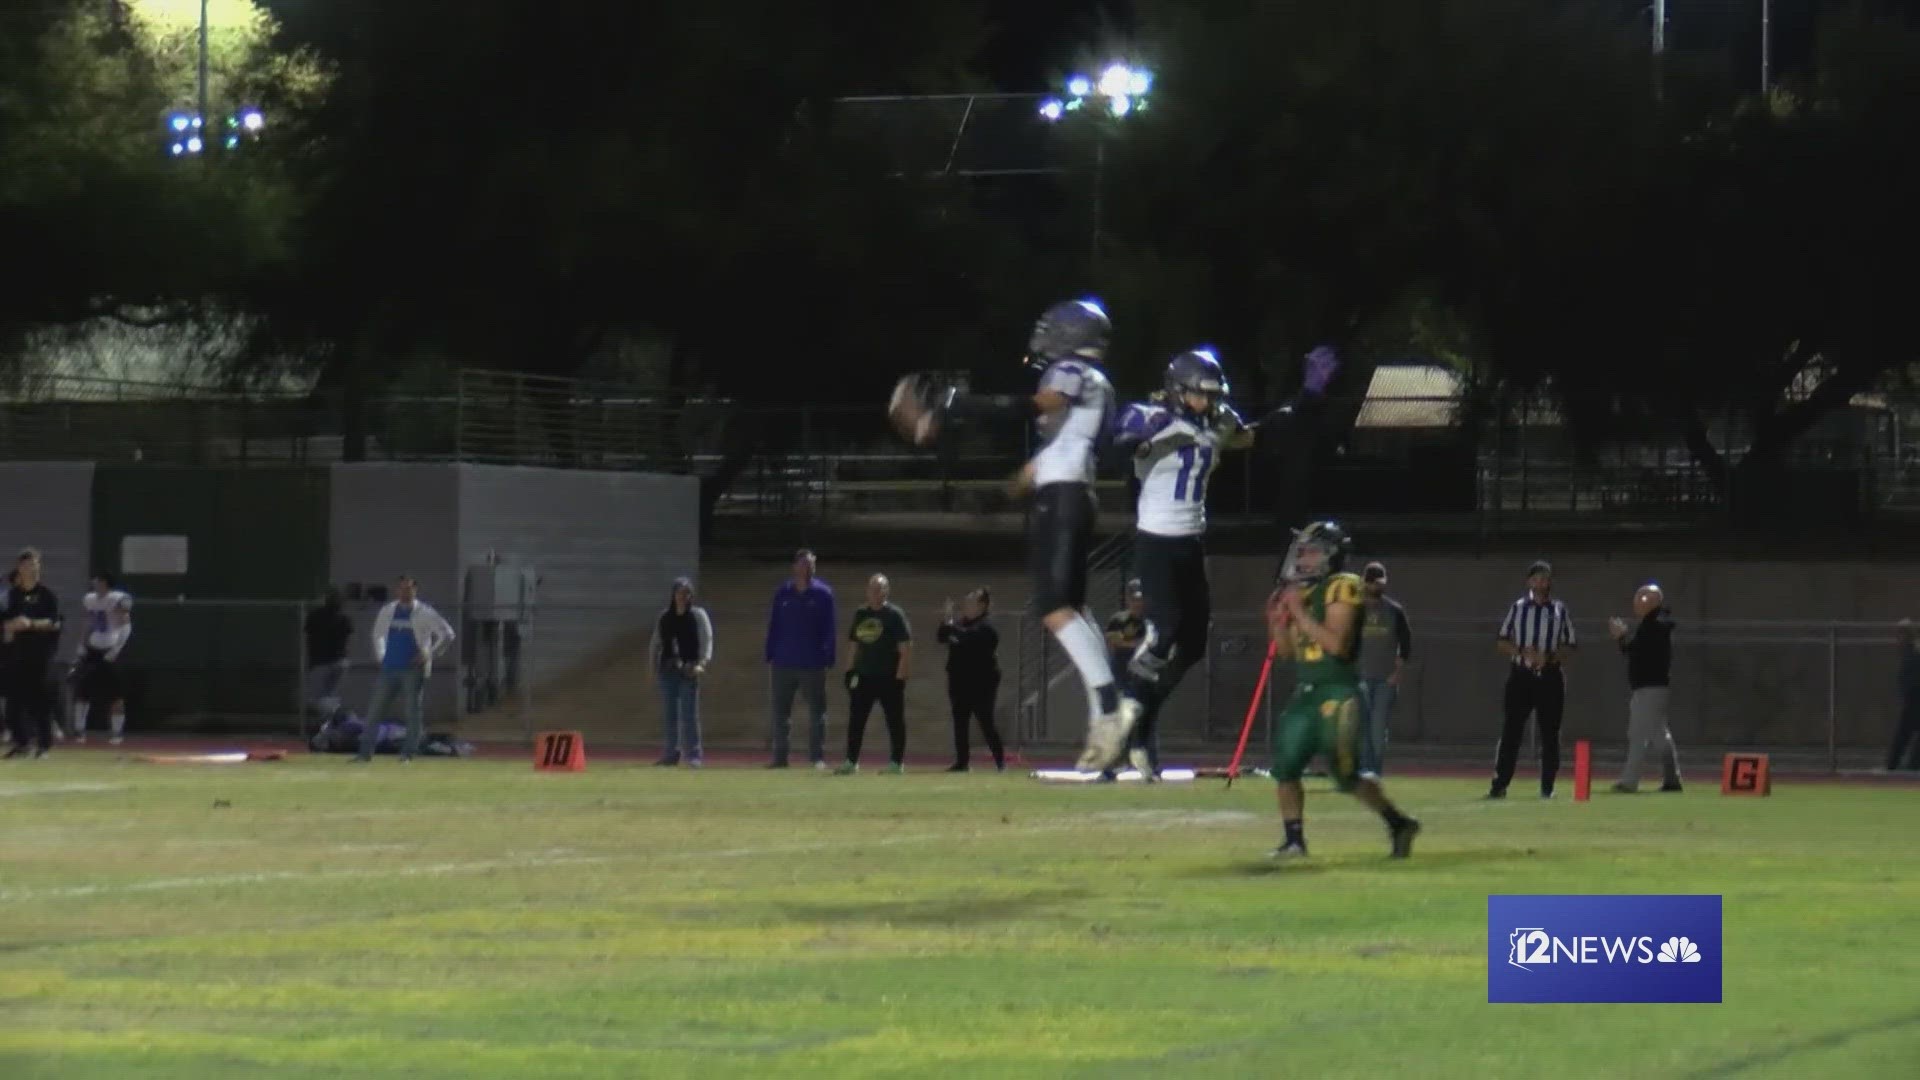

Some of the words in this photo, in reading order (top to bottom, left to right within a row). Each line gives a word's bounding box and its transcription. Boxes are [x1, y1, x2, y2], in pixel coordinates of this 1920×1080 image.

[1174, 445, 1212, 502] 11
[543, 735, 573, 766] 10
[1731, 758, 1759, 790] G
